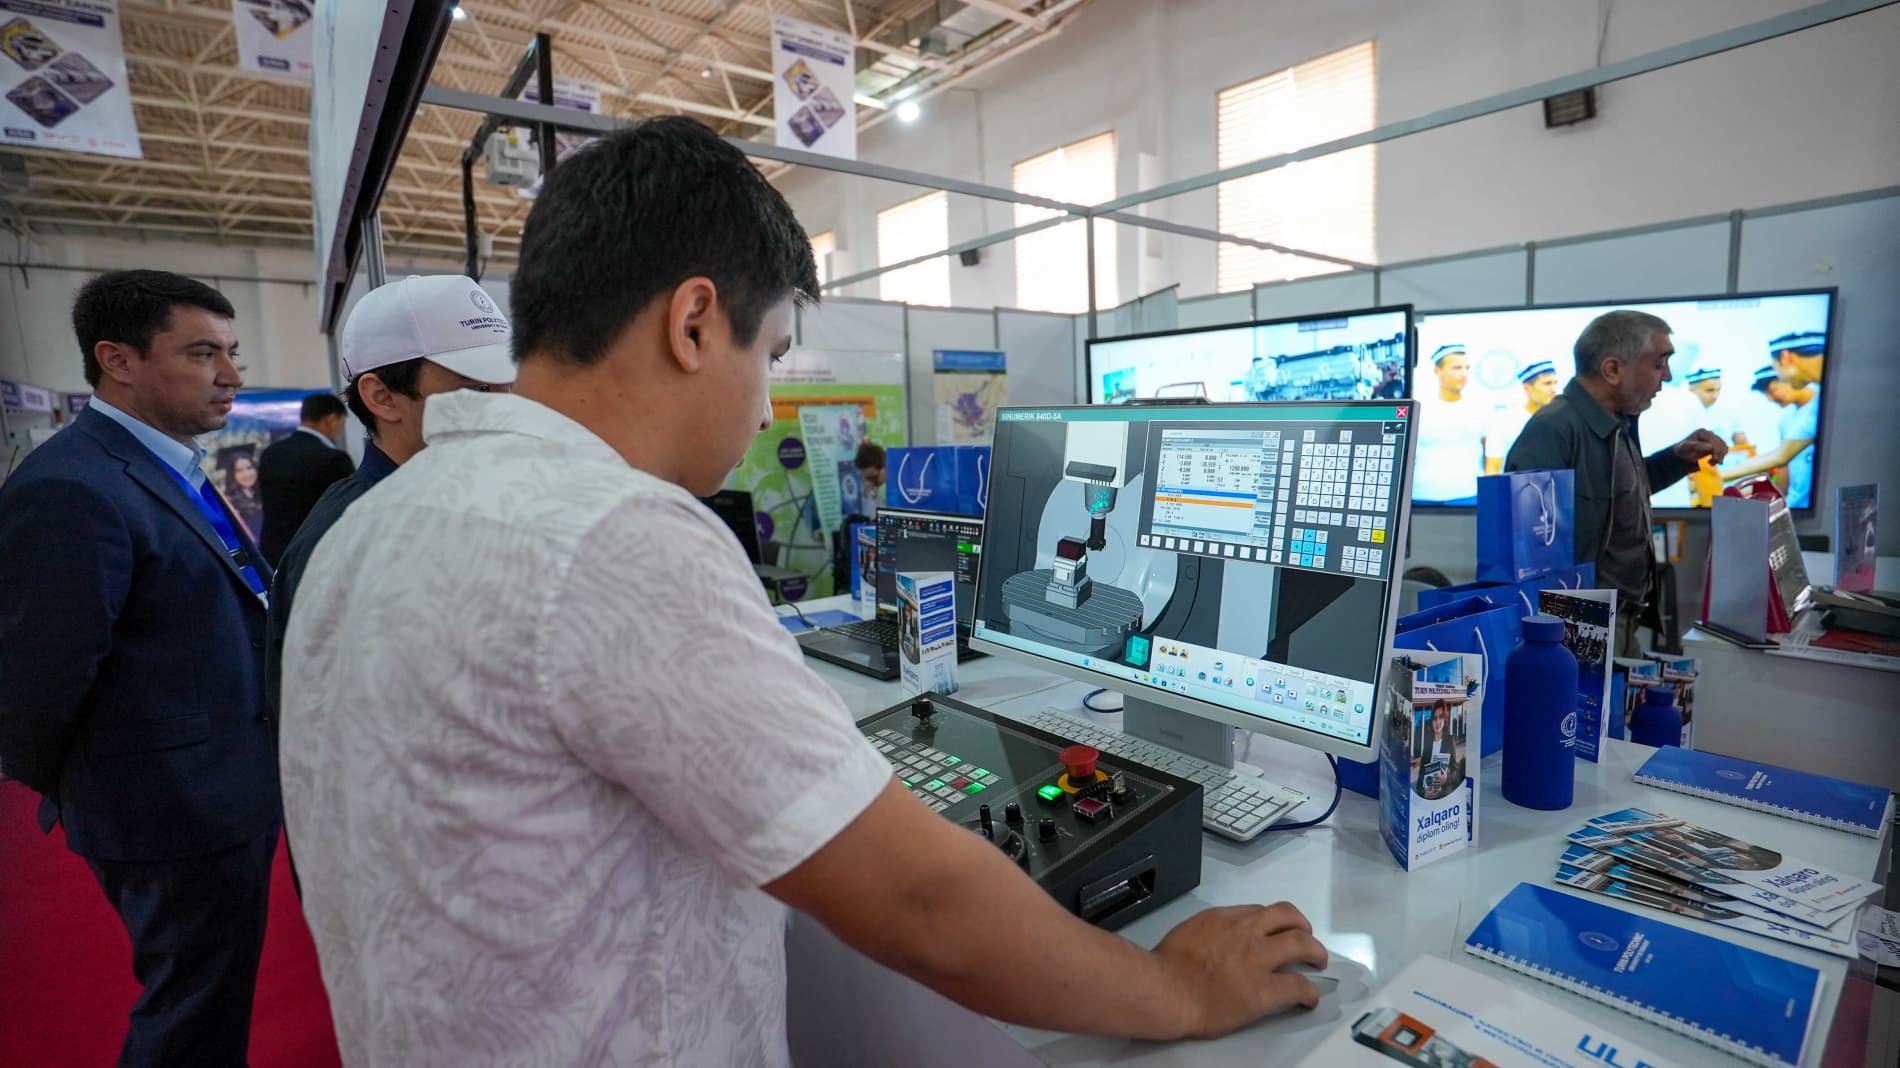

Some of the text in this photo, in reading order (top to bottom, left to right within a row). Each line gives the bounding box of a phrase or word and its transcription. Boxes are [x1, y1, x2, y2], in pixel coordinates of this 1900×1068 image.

[459, 318, 482, 327] TURIN
[1001, 412, 1035, 421] SINUMERIK
[1416, 804, 1460, 832] Xalqaro
[1416, 817, 1460, 844] diplom oling!
[1761, 868, 1820, 888] Xalqaro
[1787, 873, 1839, 895] diplom oling!
